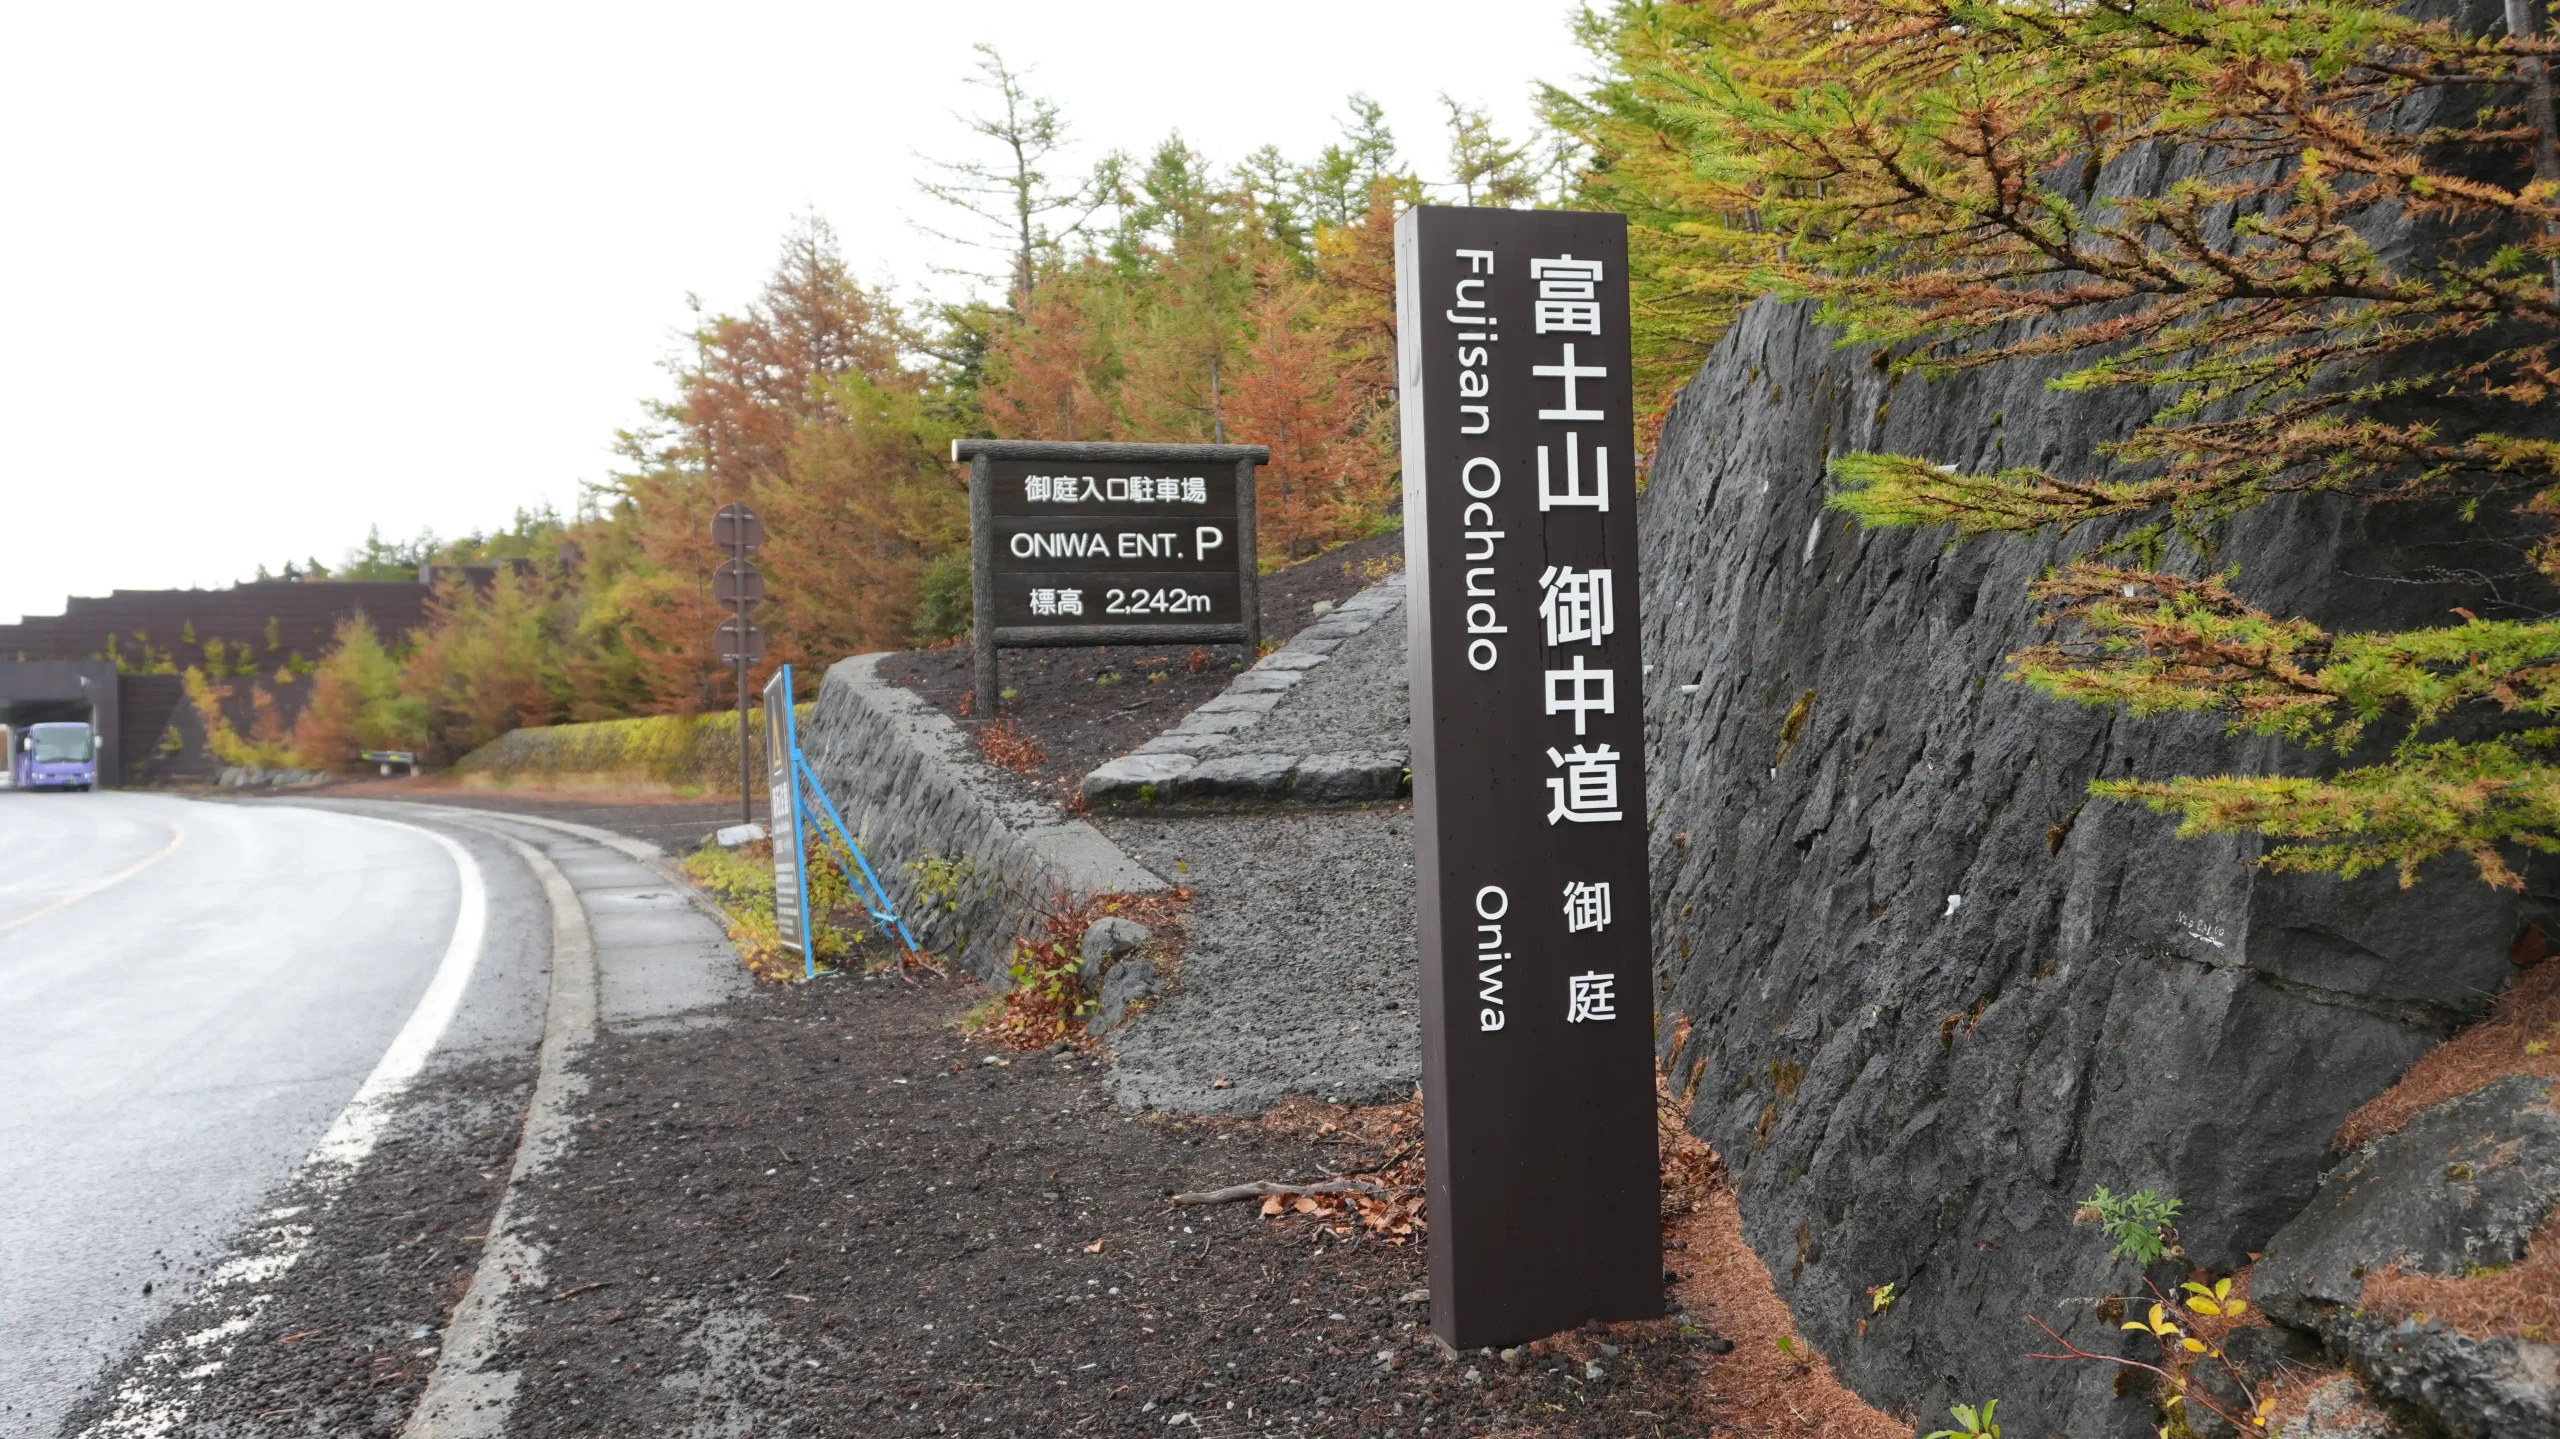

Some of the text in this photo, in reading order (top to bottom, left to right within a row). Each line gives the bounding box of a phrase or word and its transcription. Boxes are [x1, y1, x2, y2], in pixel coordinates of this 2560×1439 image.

[1024, 474, 1207, 504] 御庭入口駐車場
[1446, 248, 1508, 672] Fujisan Ochudo
[1010, 526, 1223, 562] ONIWA ENT. P
[1029, 588, 1212, 616] 標高 2,242m
[1475, 885, 1512, 1032] Oniwa
[1562, 881, 1617, 1024] 御庭
